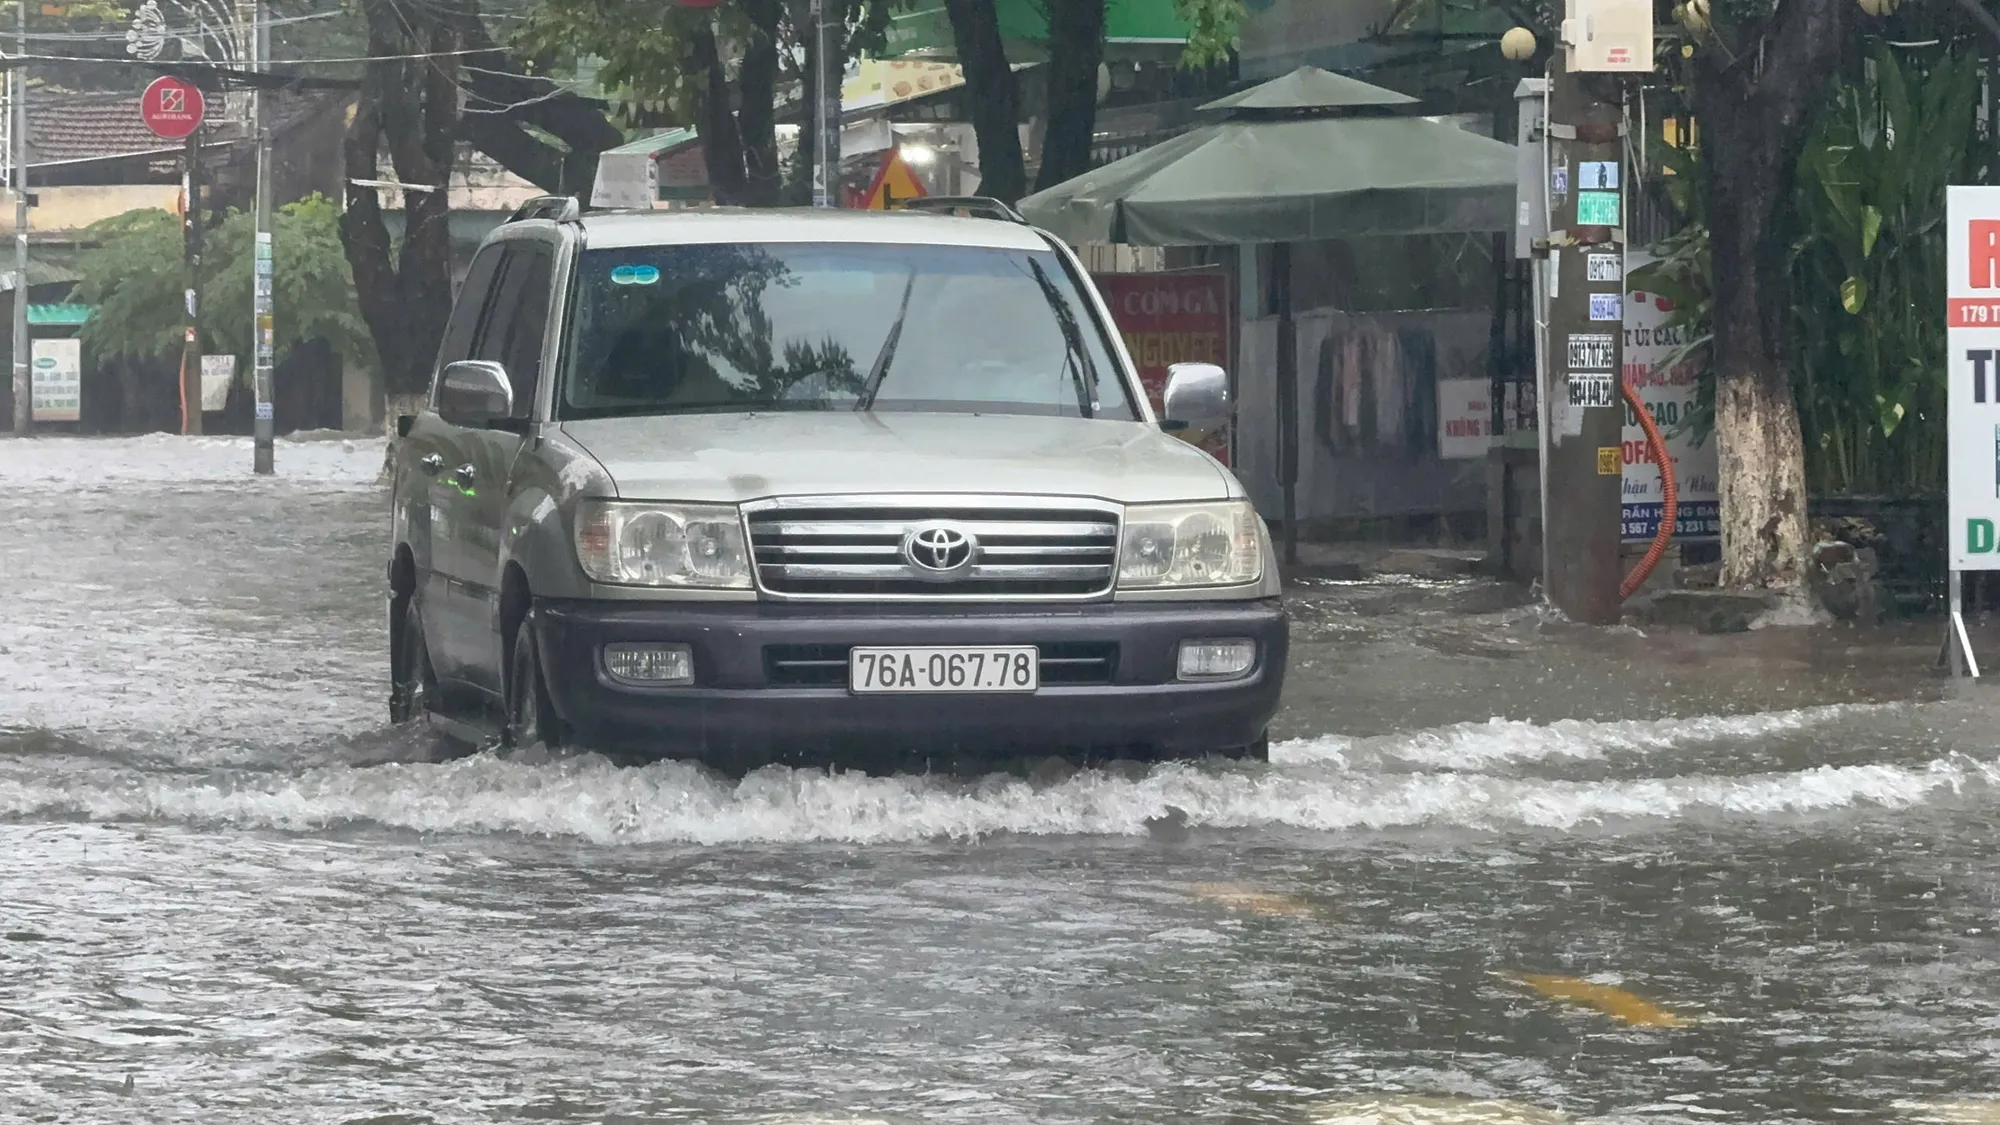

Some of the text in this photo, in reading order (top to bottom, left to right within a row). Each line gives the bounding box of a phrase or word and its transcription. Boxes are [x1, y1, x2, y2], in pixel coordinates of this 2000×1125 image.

[1961, 305, 1988, 323] 179
[1966, 349, 2000, 403] T
[1629, 522, 1648, 534] 567
[1967, 519, 2000, 554] D
[859, 653, 1031, 687] 76A-067.78
